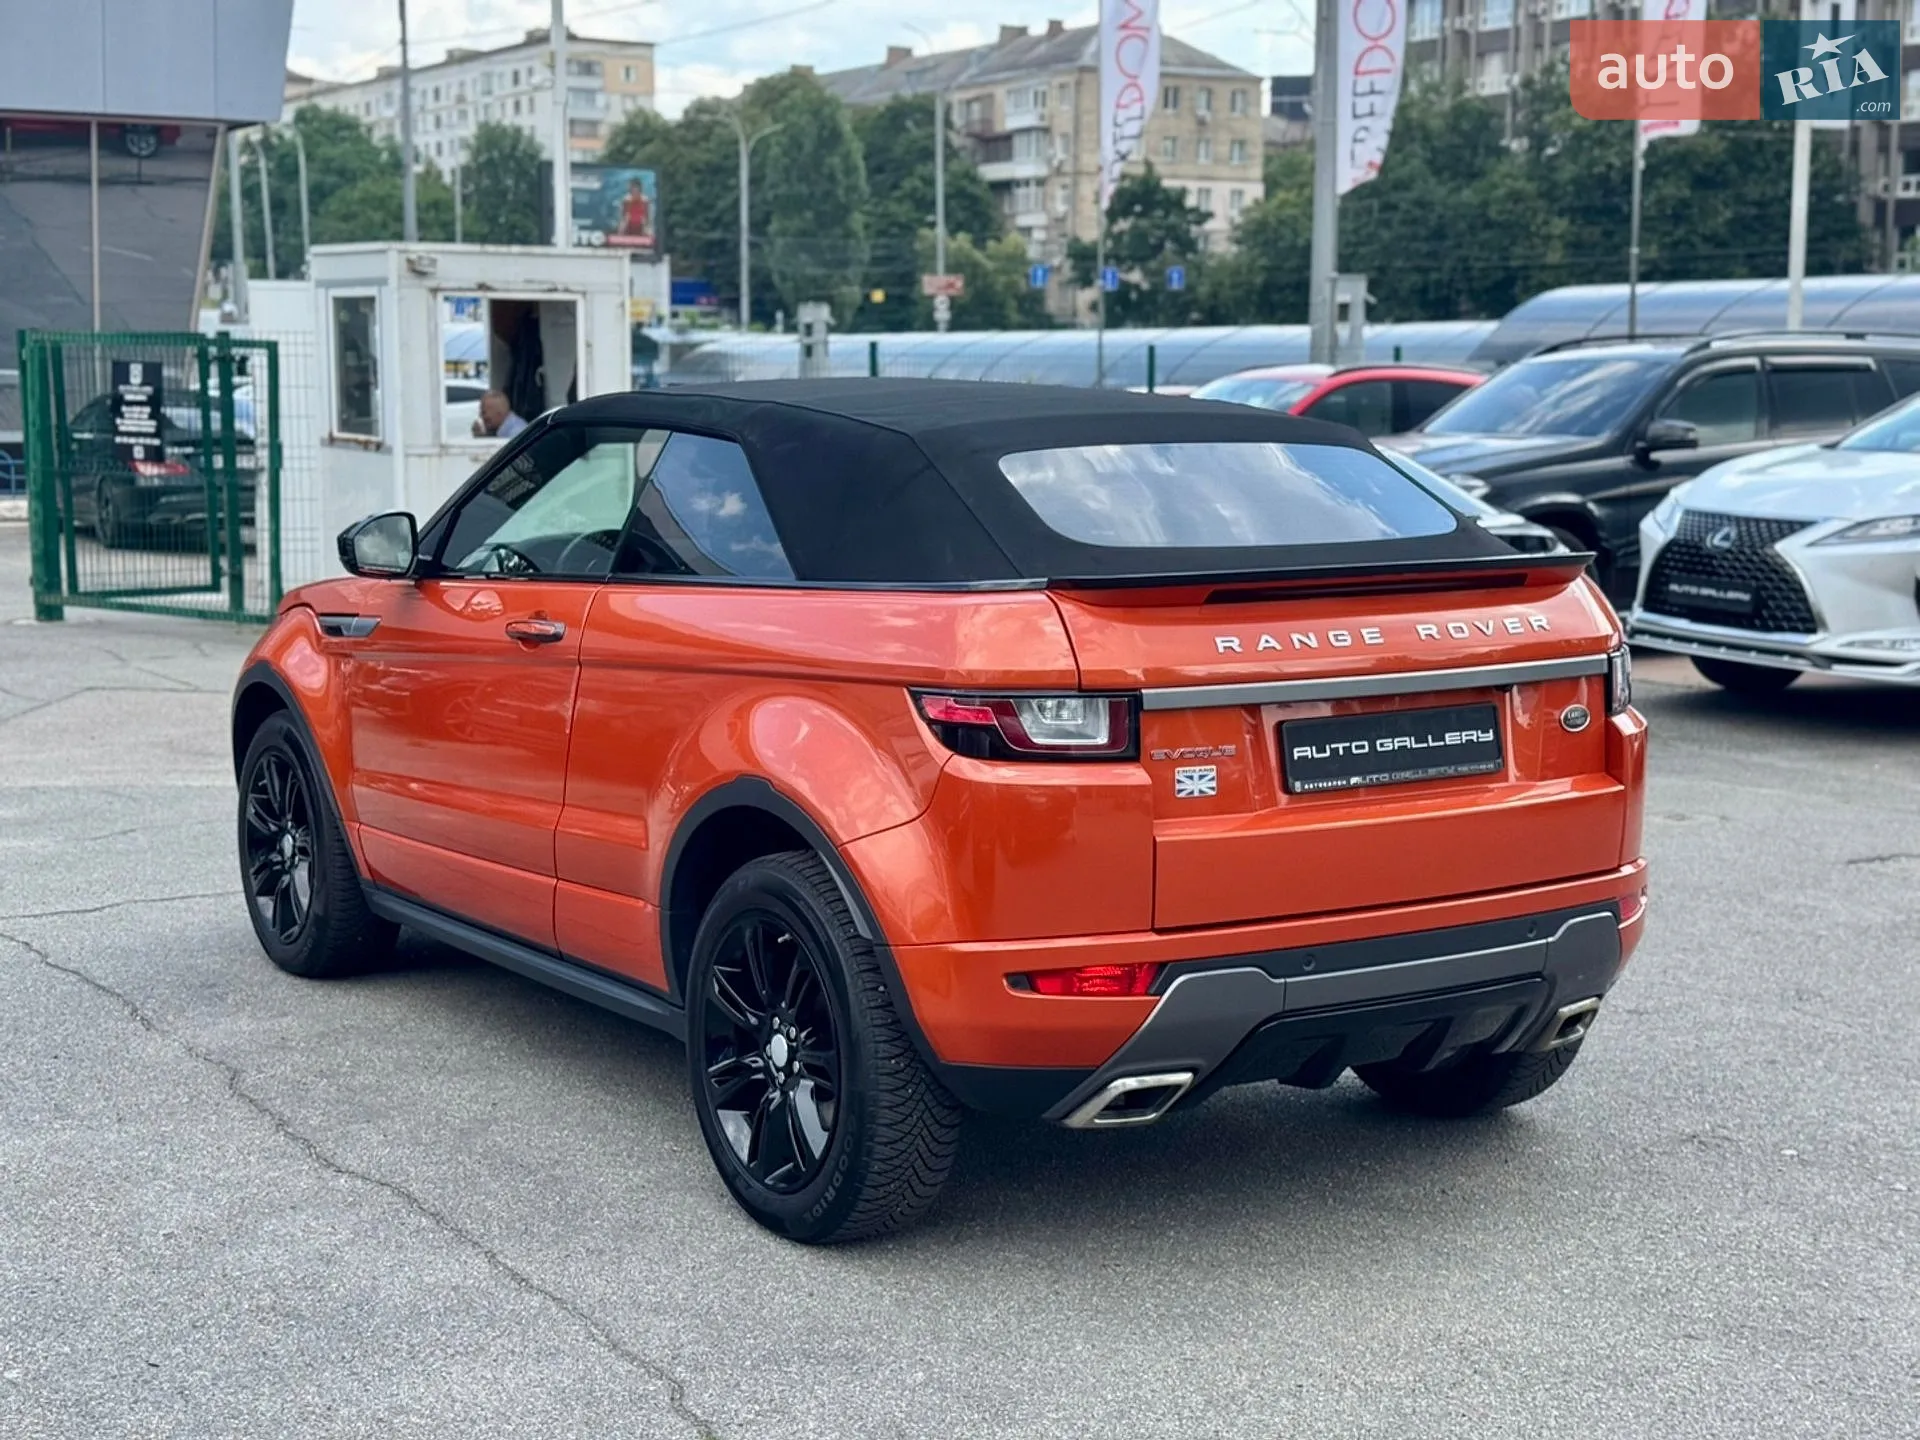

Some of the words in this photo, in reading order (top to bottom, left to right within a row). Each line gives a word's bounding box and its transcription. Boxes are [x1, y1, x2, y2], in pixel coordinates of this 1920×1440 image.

[1214, 627, 1385, 655] RANGE
[1415, 614, 1552, 641] ROVER
[1150, 745, 1236, 760] EVOQUE
[1293, 740, 1369, 762] AUTO
[1376, 728, 1495, 752] GALLERY
